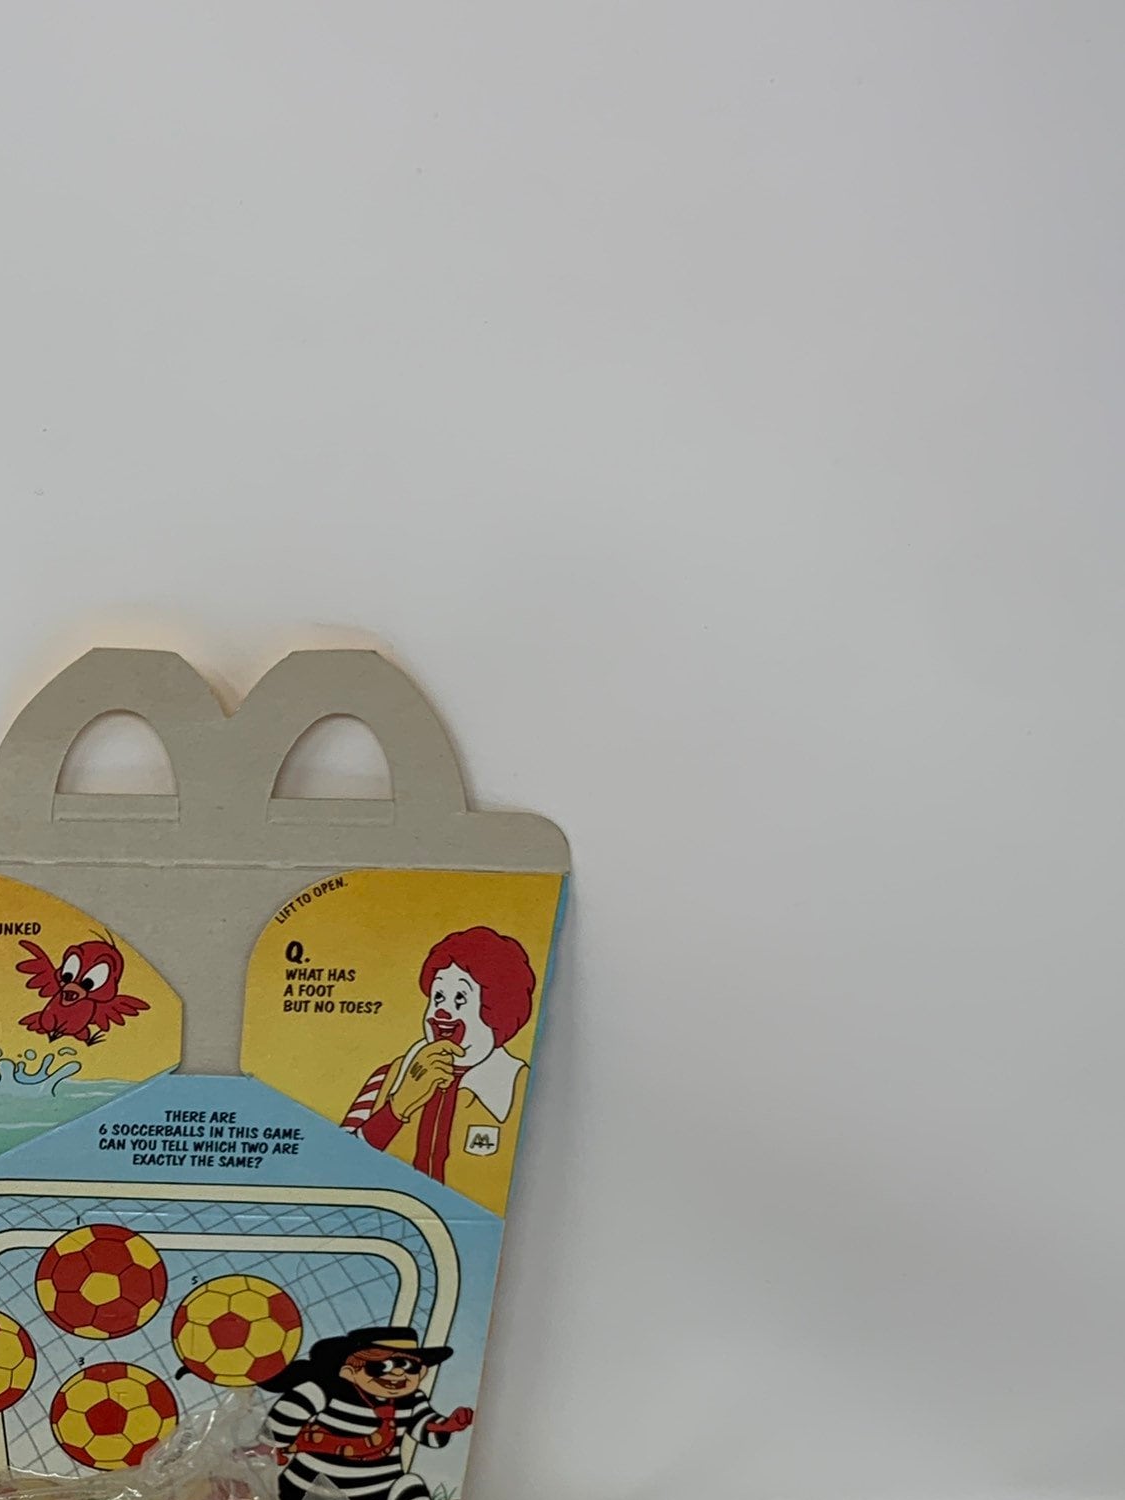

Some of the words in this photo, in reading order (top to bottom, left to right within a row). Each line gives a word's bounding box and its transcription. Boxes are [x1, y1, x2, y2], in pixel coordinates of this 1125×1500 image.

[275, 901, 297, 925] LIFT
[295, 893, 312, 907] TO
[312, 877, 349, 897] OPEN.
[285, 940, 311, 964] Q.
[285, 968, 324, 981] WHAT
[327, 968, 356, 982] HAS
[283, 984, 294, 997] A
[298, 984, 335, 998] FOOT
[283, 1000, 311, 1013] BUT
[314, 1000, 335, 1013] NO
[339, 1001, 383, 1014] TOES?
[165, 1110, 206, 1123] THERE
[209, 1111, 237, 1124] ARE
[99, 1124, 108, 1136] 6
[112, 1124, 205, 1138] SOCCERBALLS
[209, 1126, 224, 1138] IN
[228, 1126, 258, 1139] THIS
[262, 1128, 305, 1141] GAME.
[99, 1138, 125, 1151] CAN
[130, 1139, 157, 1151] YOU
[162, 1139, 189, 1152] TELL
[193, 1141, 236, 1153] WHICH
[241, 1142, 269, 1155] TWO
[272, 1143, 299, 1155] ARE
[132, 1154, 187, 1166] EXACTLY
[190, 1155, 215, 1167] THE
[218, 1156, 263, 1169] SAME?
